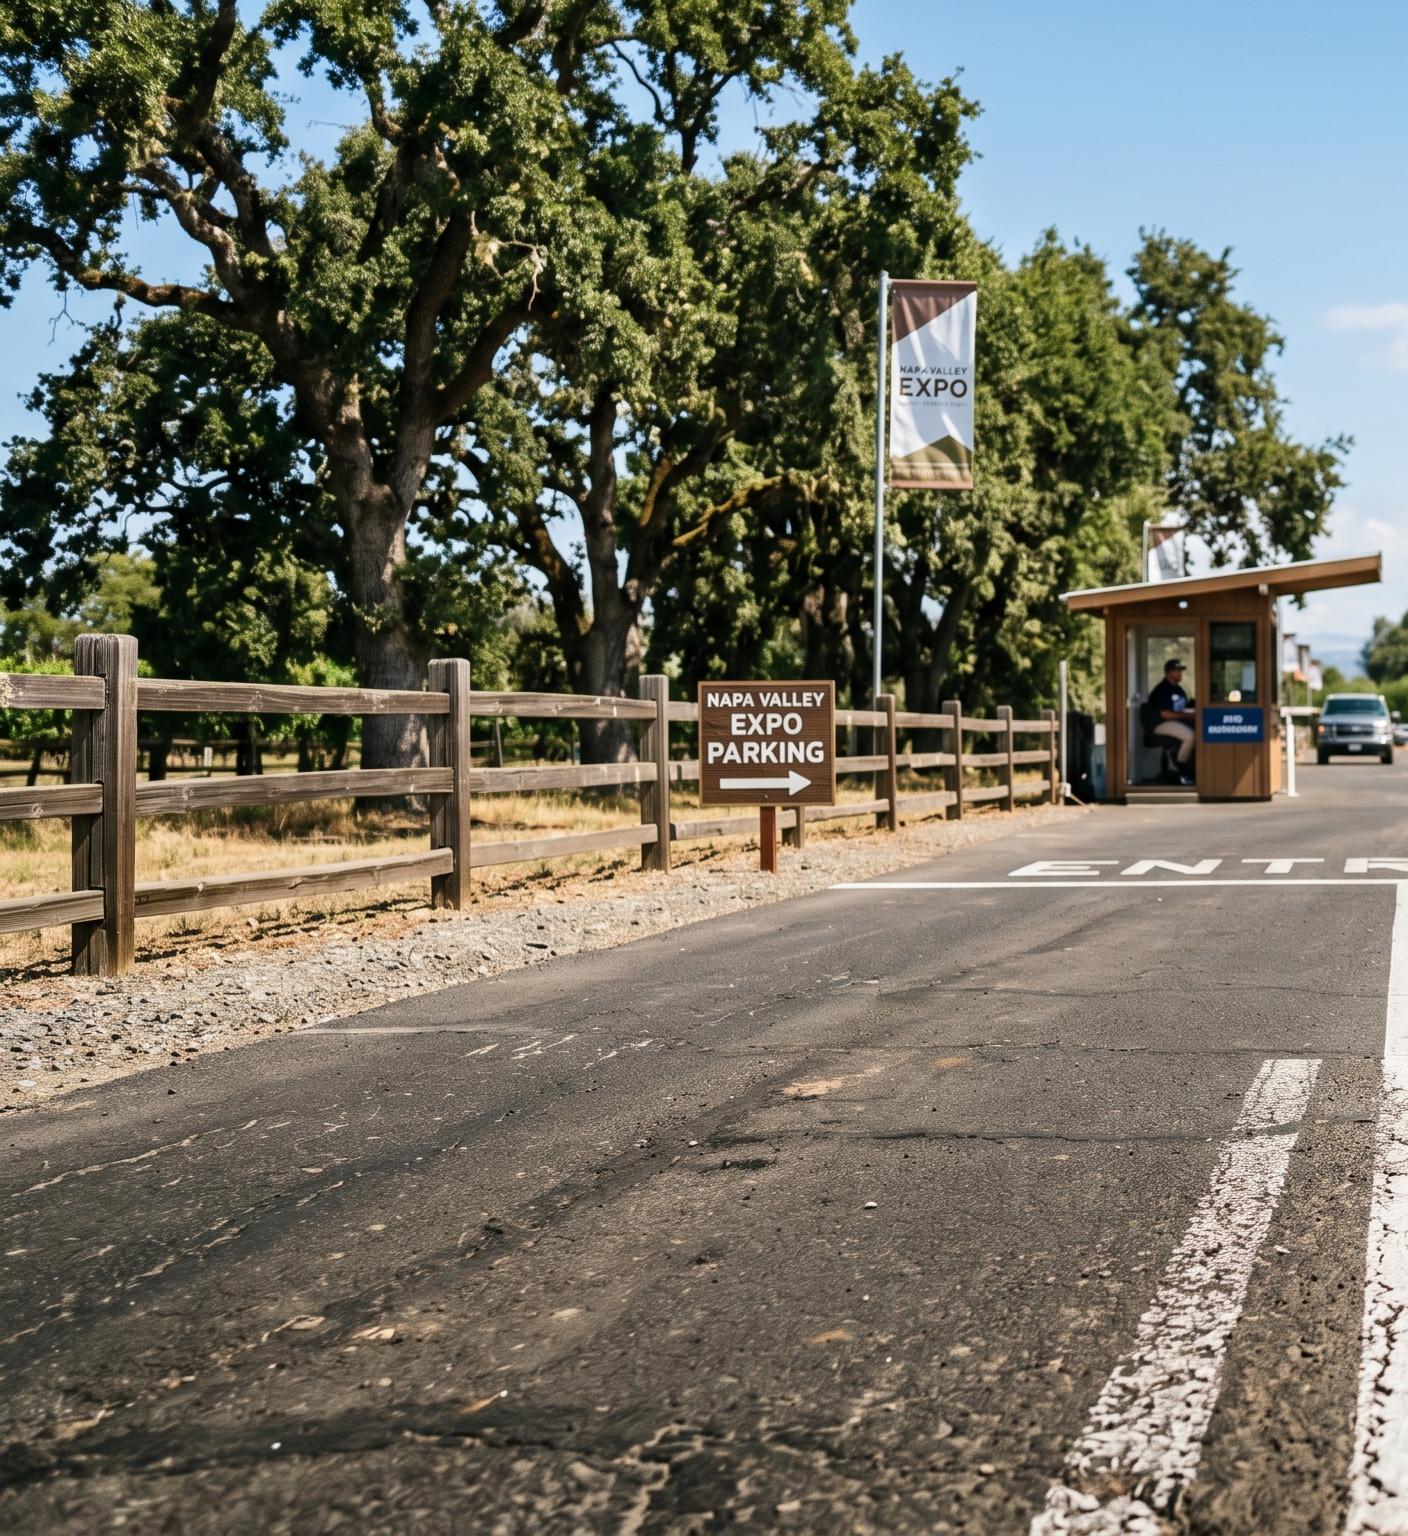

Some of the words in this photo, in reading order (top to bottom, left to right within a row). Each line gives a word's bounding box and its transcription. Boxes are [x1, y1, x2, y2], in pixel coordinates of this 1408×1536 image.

[900, 366, 928, 374] NAPA
[930, 367, 967, 375] VALLEY
[900, 378, 967, 398] EXPO
[707, 693, 755, 707] NAPA
[759, 692, 824, 707] VALLEY
[730, 712, 803, 736] EXPO
[707, 741, 825, 765] PARKING
